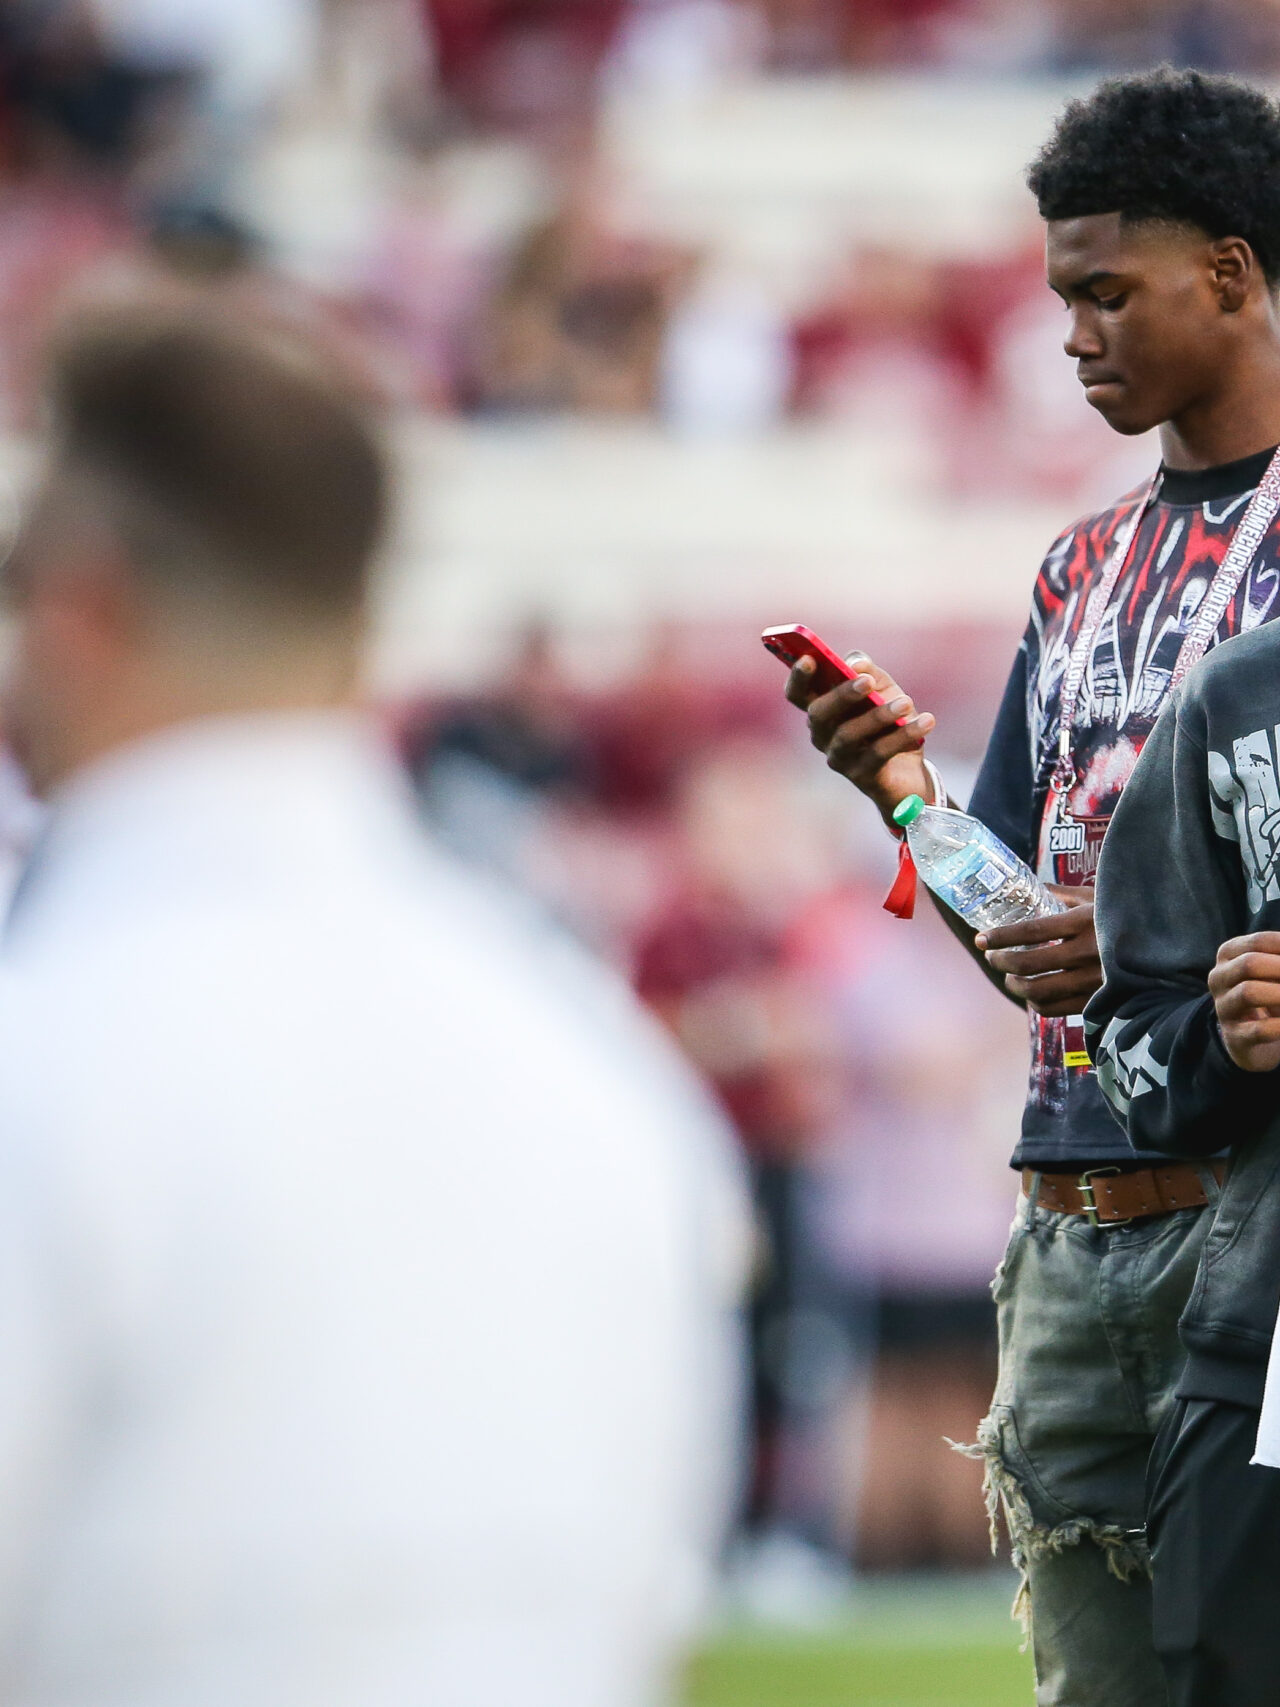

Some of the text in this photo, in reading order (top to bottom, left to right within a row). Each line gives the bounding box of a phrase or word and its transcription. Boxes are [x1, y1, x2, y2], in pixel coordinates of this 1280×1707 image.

[1190, 493, 1276, 648] GAMECOCK FOOTBALL
[1050, 827, 1082, 851] 2001
